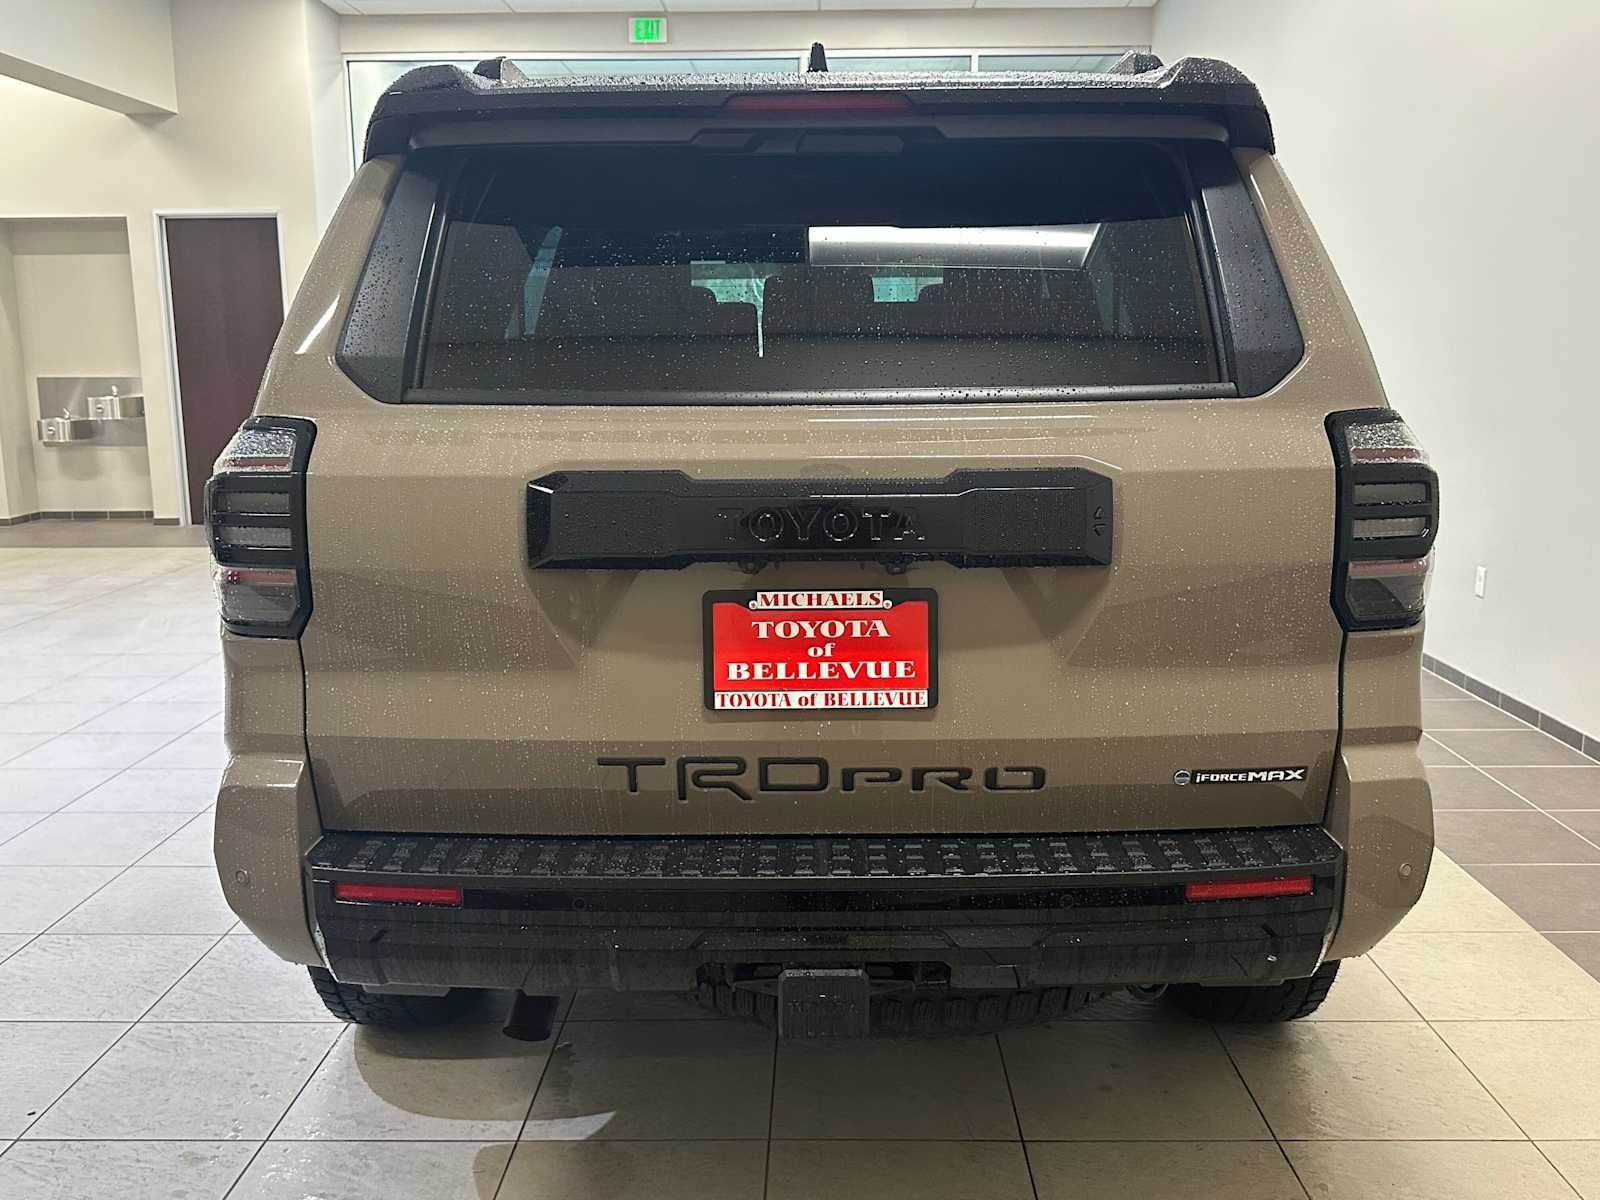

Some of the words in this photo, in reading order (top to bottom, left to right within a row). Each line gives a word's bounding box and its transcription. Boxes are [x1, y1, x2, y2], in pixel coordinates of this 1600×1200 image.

[634, 18, 661, 41] EXIT
[714, 506, 926, 542] TOYOTA
[759, 592, 882, 606] MICHAELS
[751, 619, 891, 639] TOYOTA
[807, 642, 836, 657] of
[727, 660, 917, 681] BELLEVUE
[716, 693, 792, 708] TOYOTA
[798, 692, 818, 707] of
[823, 691, 926, 706] BELLEVUE
